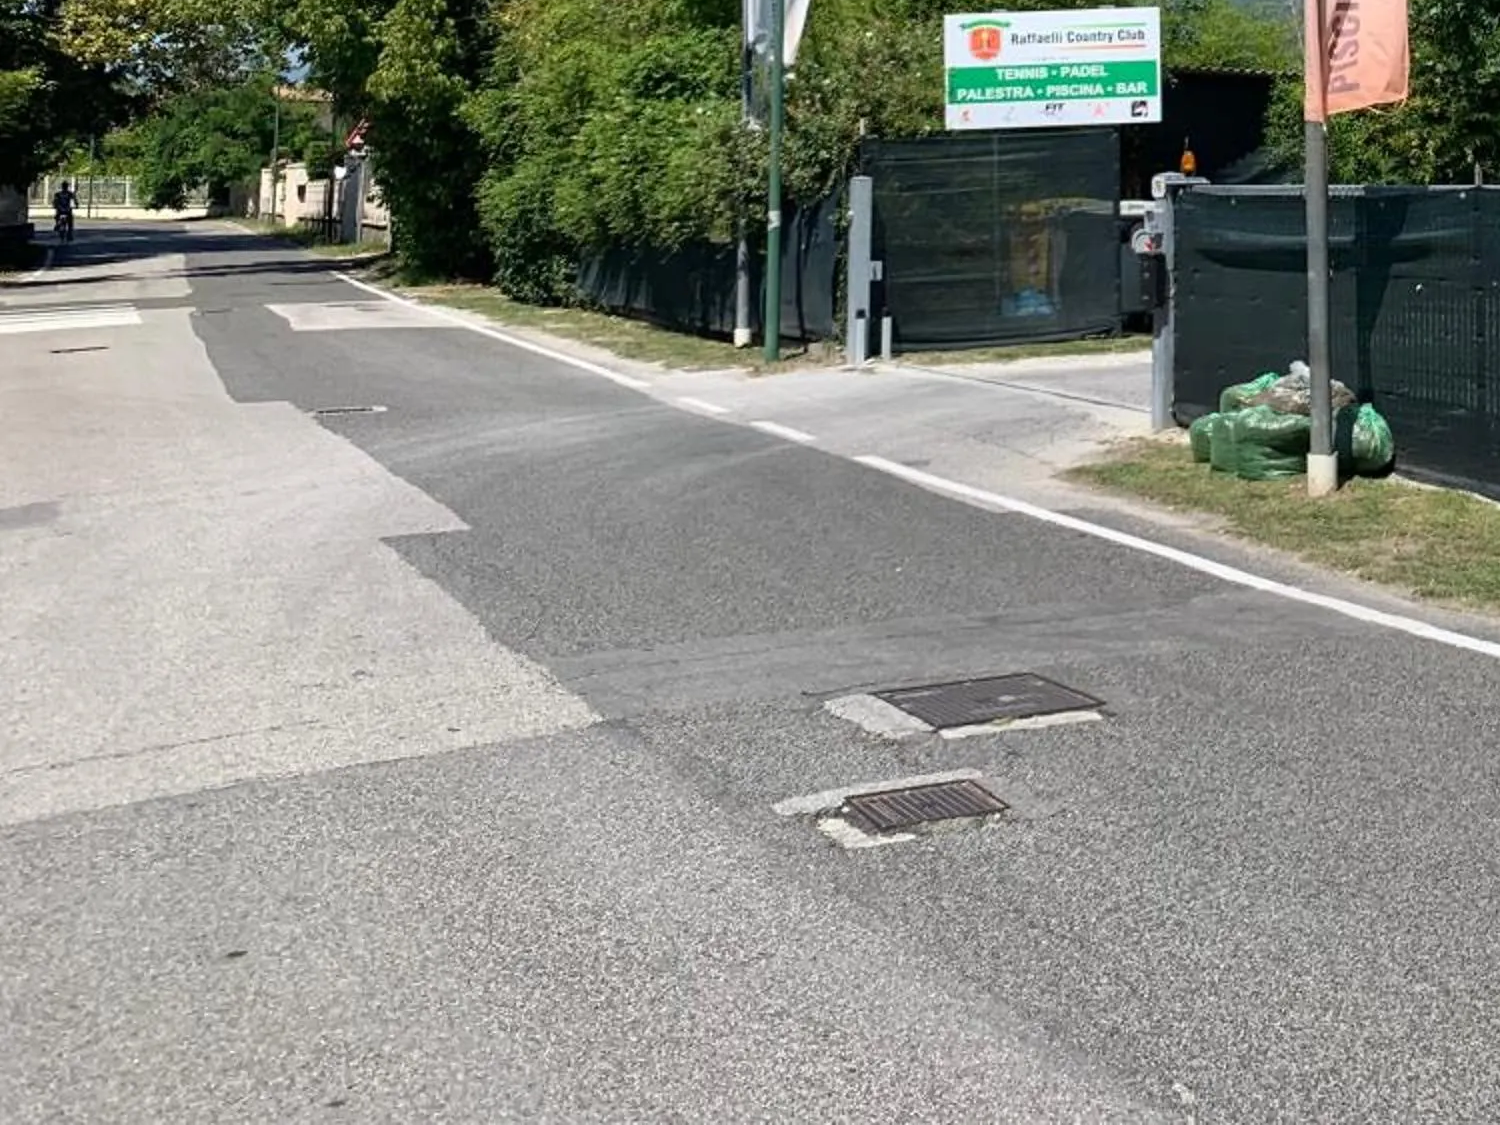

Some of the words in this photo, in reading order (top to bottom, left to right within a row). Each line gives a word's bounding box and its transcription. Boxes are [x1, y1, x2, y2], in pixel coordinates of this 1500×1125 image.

[1011, 32, 1064, 45] Raffaelli
[1067, 29, 1113, 43] Country
[1117, 28, 1145, 41] Club
[996, 67, 1048, 80] TENNIS
[1060, 64, 1109, 78] PADEL
[957, 85, 1035, 101] PALESTRA
[1045, 83, 1104, 97] PISCINA
[1116, 81, 1148, 94] BAR
